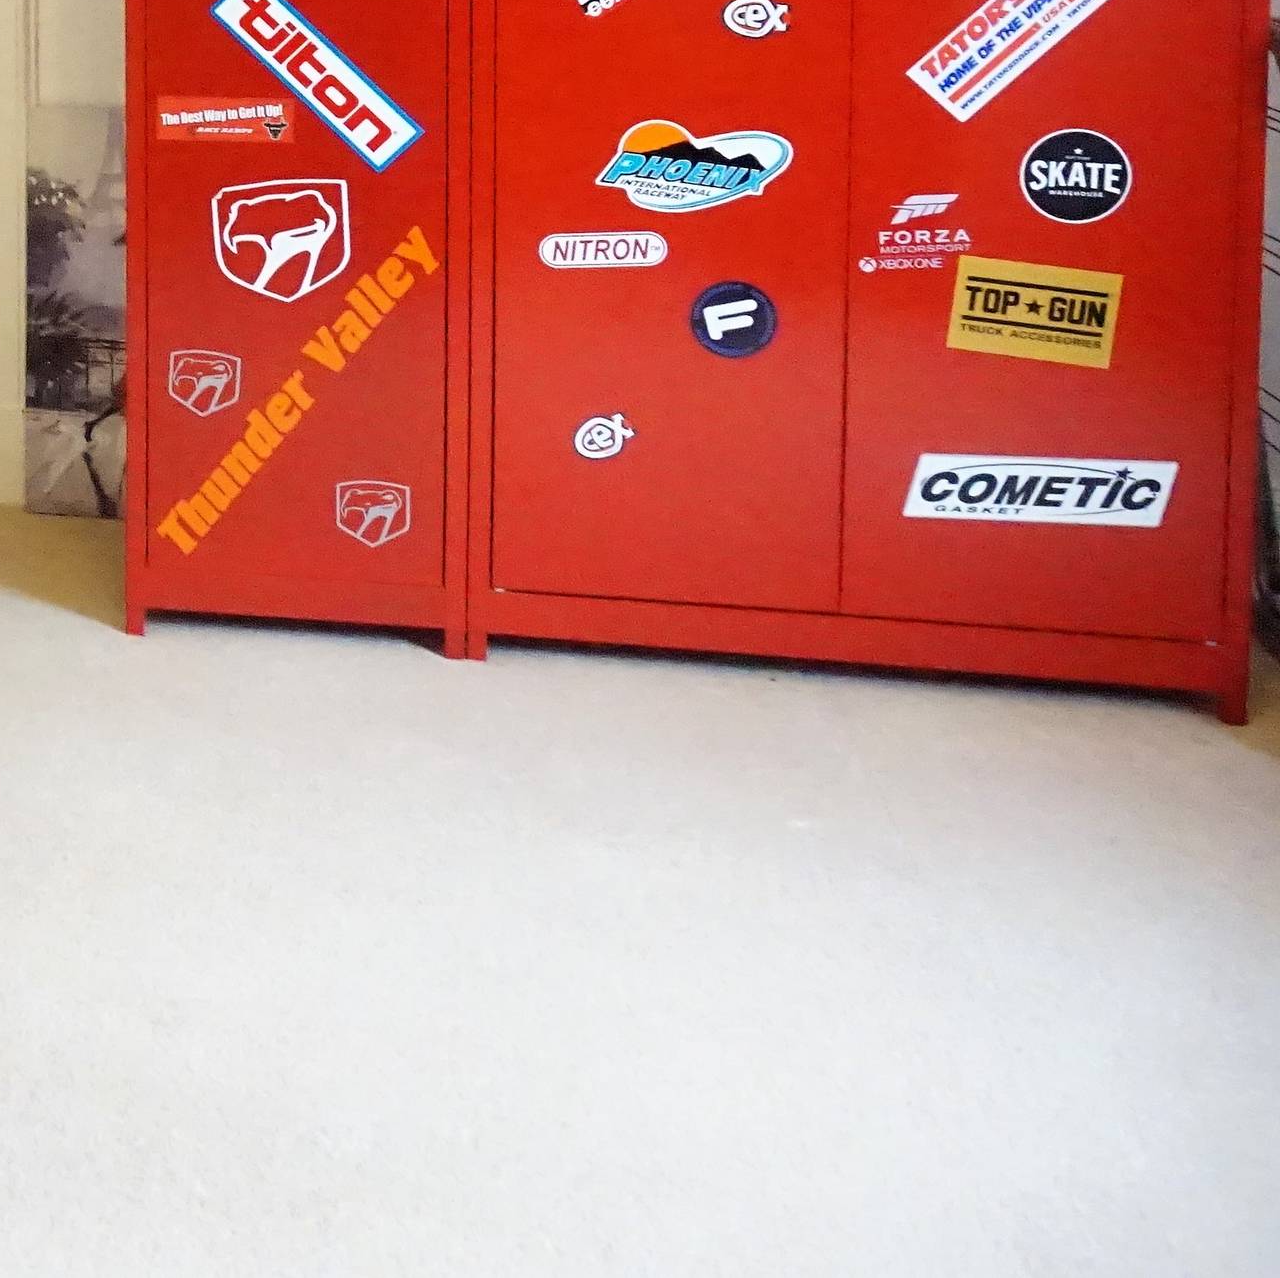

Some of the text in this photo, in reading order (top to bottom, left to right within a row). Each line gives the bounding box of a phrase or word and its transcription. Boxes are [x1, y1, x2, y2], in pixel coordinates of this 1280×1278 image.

[1042, 1, 1068, 23] USA
[937, 55, 980, 93] HOME
[977, 39, 997, 60] OF
[995, 16, 1024, 43] THE
[161, 113, 180, 126] The
[180, 112, 204, 123] Best
[204, 110, 226, 122] Way
[238, 107, 256, 118] Get
[265, 104, 283, 117] Up!
[602, 151, 764, 192] PHOENIX
[1029, 159, 1123, 195] SKATE
[620, 179, 711, 196] INTERNATIONAL
[634, 188, 685, 200] RACEWAY
[878, 229, 972, 245] FORZA
[879, 243, 972, 254] MOTORSPORT
[552, 238, 649, 262] NITRON
[878, 258, 944, 270] XBOX ONE
[965, 284, 1108, 328] TOP GUN
[960, 322, 1102, 349] TRUCK ACCESSORIES
[156, 225, 440, 555] Thunder Valley
[920, 468, 1161, 511] COMETIC
[934, 505, 1025, 516] GASKET
